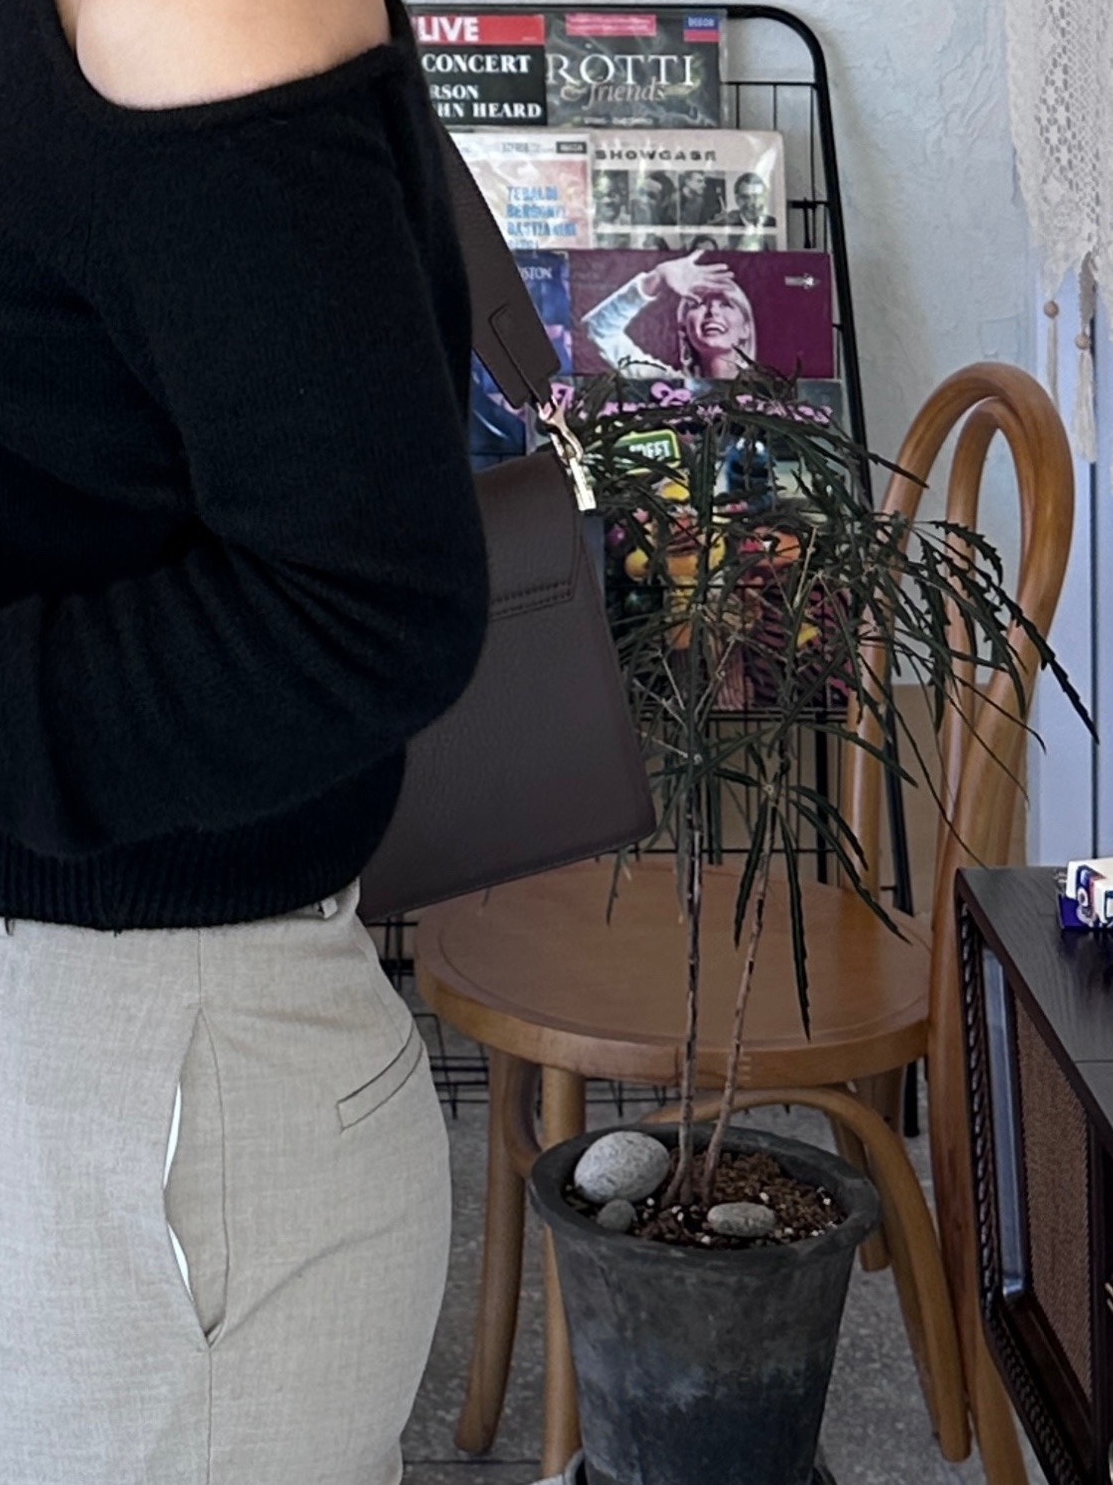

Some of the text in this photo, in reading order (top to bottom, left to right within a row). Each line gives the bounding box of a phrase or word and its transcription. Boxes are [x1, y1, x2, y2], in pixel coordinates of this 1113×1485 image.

[418, 16, 480, 42] LIVE
[421, 53, 532, 73] CONCERT
[545, 53, 695, 86] ROTTI
[581, 75, 667, 111] friends
[433, 102, 543, 118] HN HEARD
[594, 148, 717, 162] SHOWCASE
